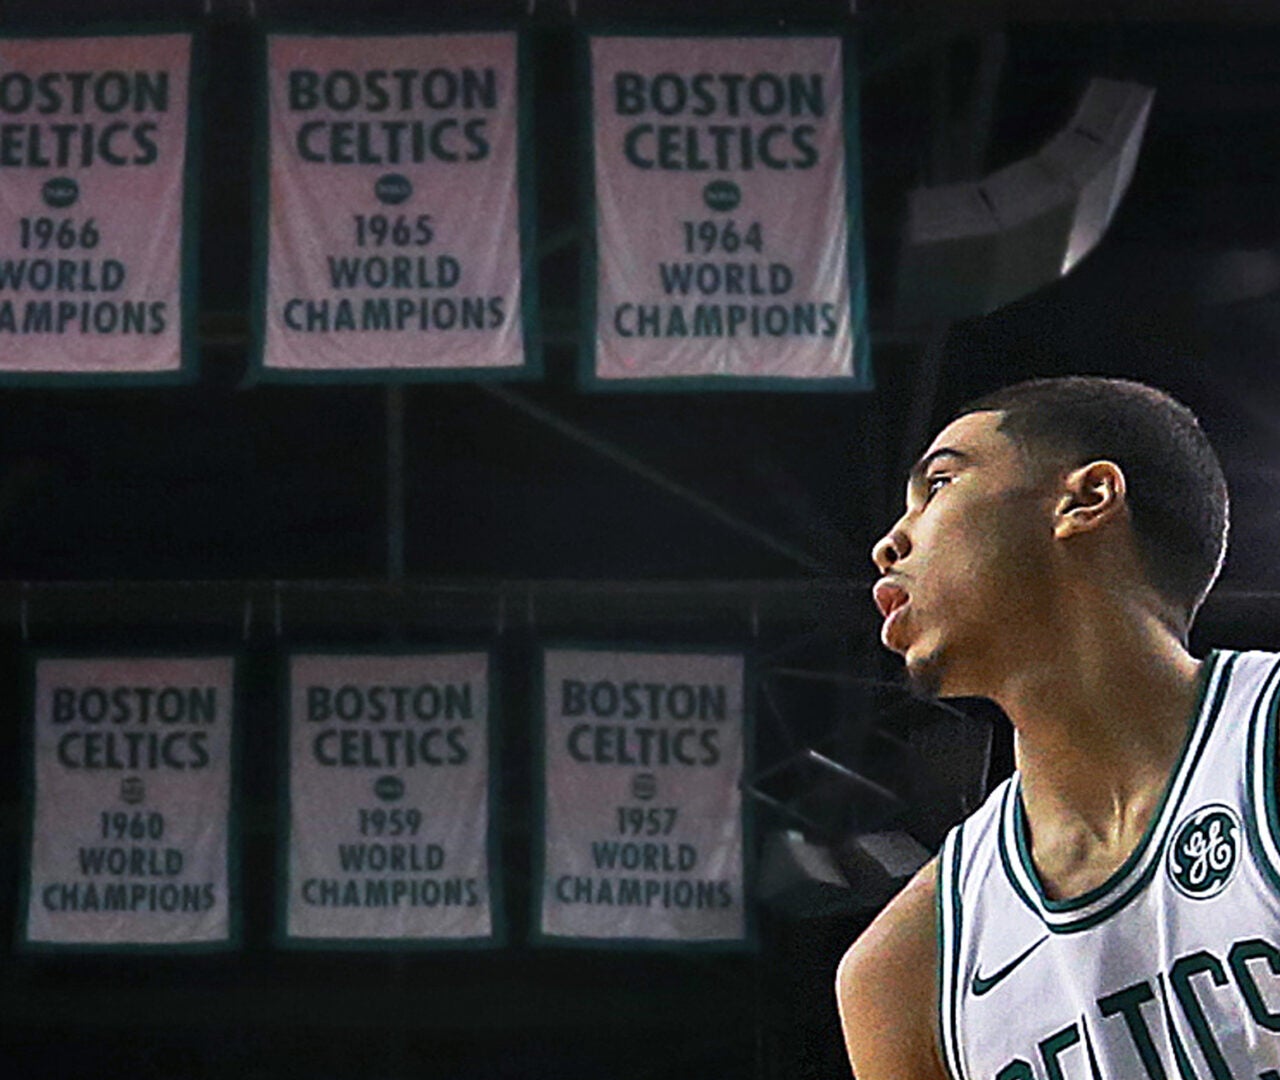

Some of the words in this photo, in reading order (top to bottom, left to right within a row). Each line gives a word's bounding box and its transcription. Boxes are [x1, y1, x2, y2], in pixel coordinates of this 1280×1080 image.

[0, 71, 168, 114] OSTON
[288, 67, 497, 112] BOSTON
[615, 71, 824, 117] BOSTON
[0, 121, 159, 168] ELTICS
[296, 118, 491, 164] CELTICS
[624, 123, 819, 170] CELTICS
[20, 217, 100, 249] 1966
[354, 214, 434, 247] 1965
[684, 221, 764, 254] 1964
[0, 259, 125, 292] WORLD
[327, 254, 461, 289] WORLD
[660, 262, 793, 295] WORLD
[0, 300, 167, 334] AMPIONS
[284, 296, 505, 332] CHAMPIONS
[615, 303, 837, 338] CHAMPIONS
[53, 686, 216, 724] BOSTON
[307, 682, 472, 722] BOSTON
[562, 679, 726, 721] BOSTON
[57, 731, 209, 770] CELTICS
[313, 727, 468, 767] CELTICS
[567, 724, 720, 766] CELTICS
[101, 811, 164, 839] 1960
[358, 808, 421, 836] 1959
[617, 806, 677, 836] 1957
[79, 847, 183, 876] WORLD
[338, 843, 444, 871] WORLD
[592, 841, 697, 871] WORLD
[42, 882, 216, 912] CHAMPIONS
[302, 878, 478, 907] CHAMPIONS
[556, 875, 733, 908] CHAMPIONS
